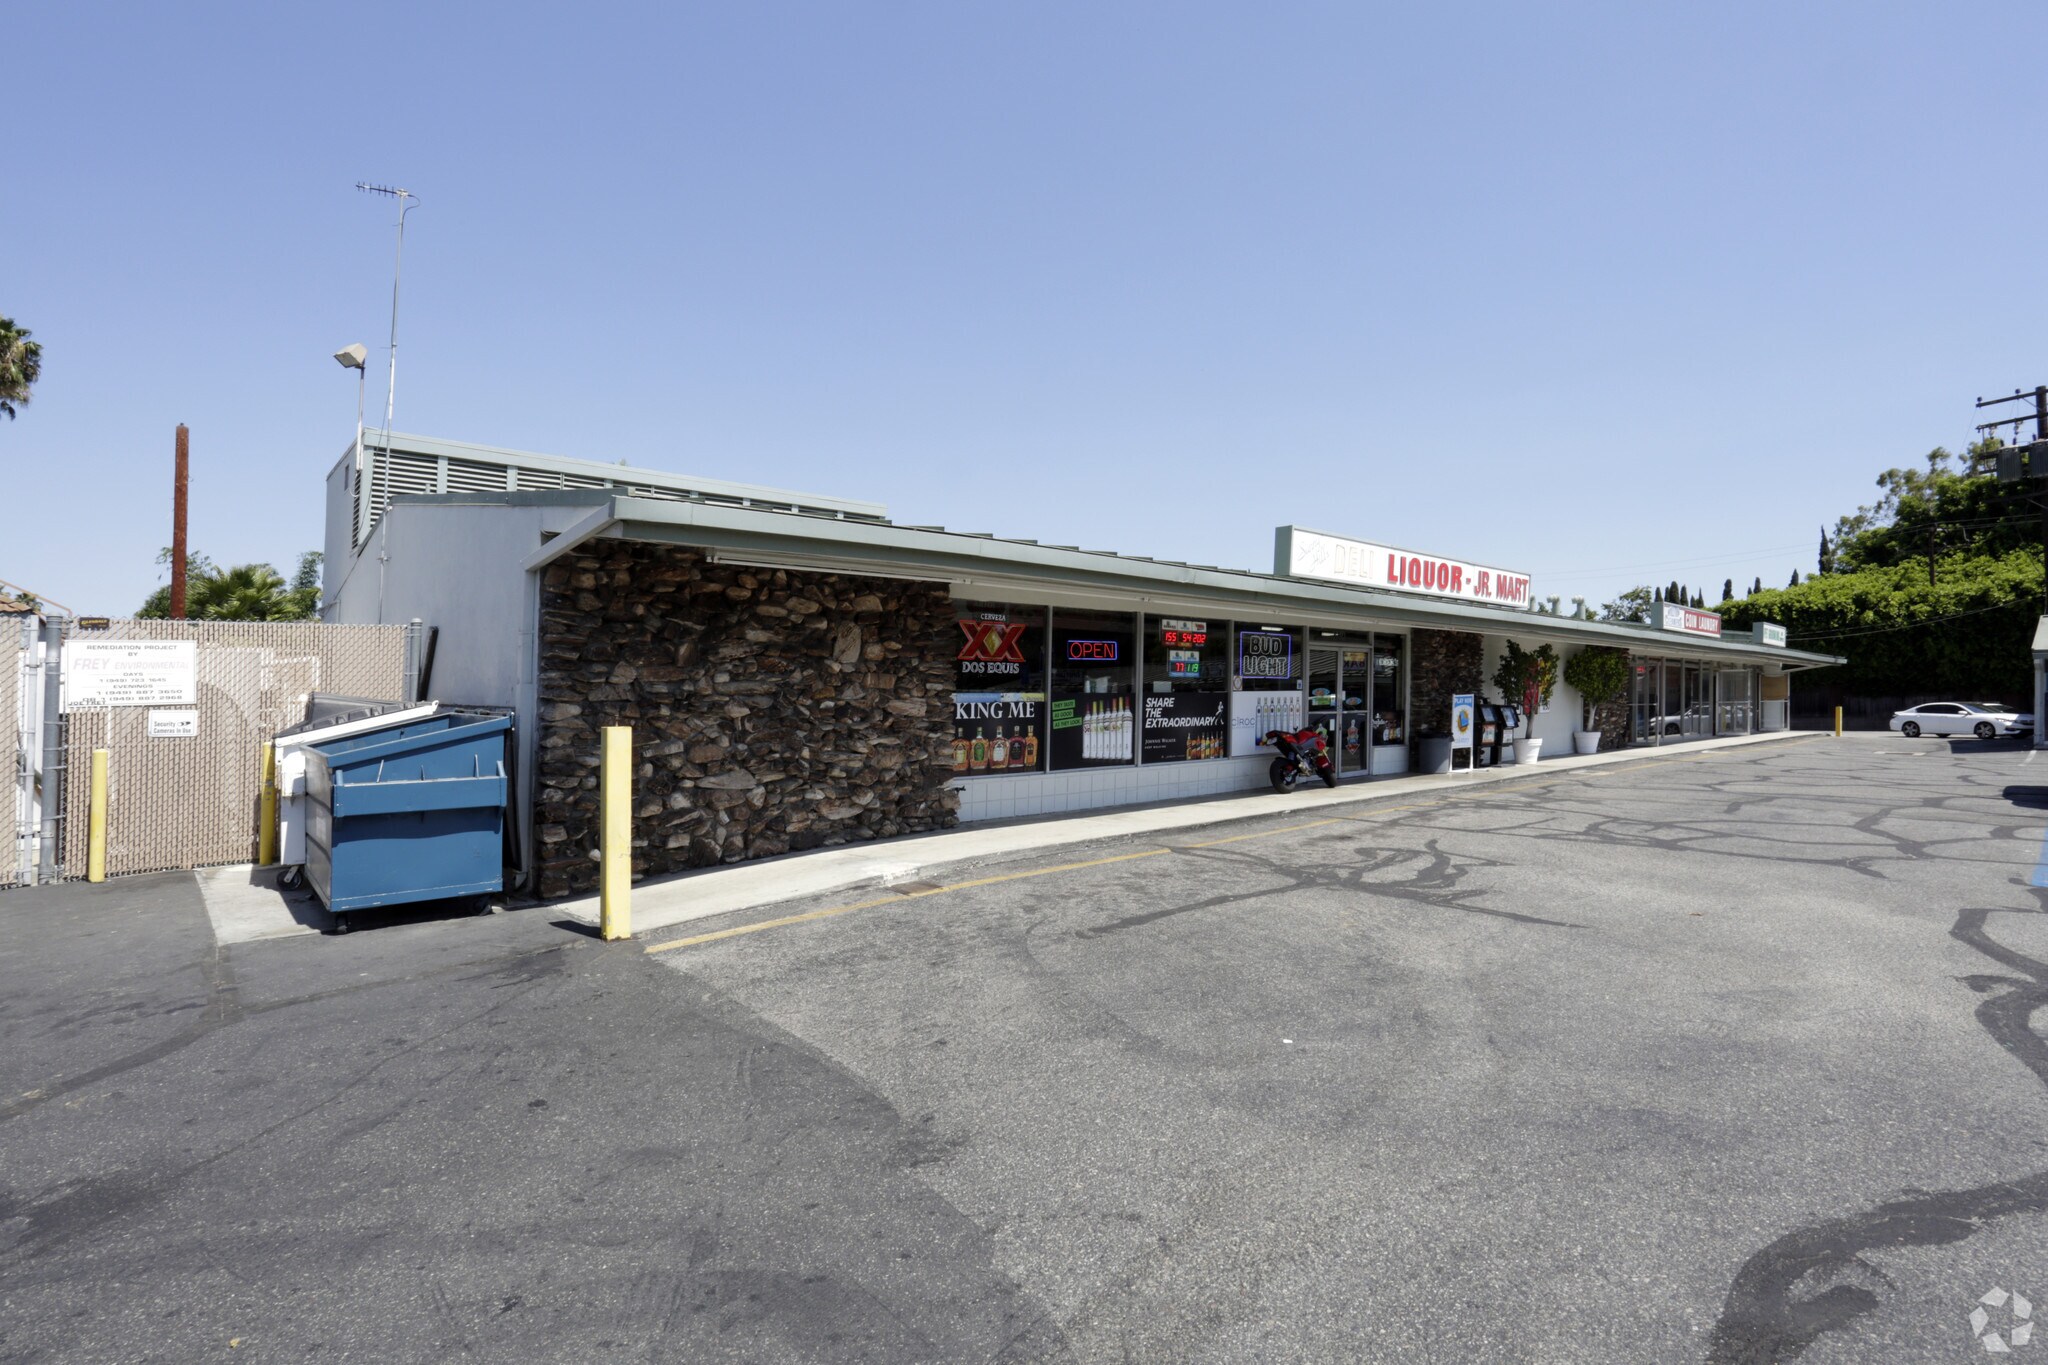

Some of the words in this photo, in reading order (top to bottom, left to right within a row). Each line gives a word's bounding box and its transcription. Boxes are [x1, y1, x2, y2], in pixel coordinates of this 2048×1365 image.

[1387, 553, 1463, 593] LIQUOR
[1496, 574, 1529, 603] MART
[980, 613, 1006, 621] CERVEZA
[1686, 613, 1697, 628] COIN
[1699, 616, 1718, 632] LAUNDRY
[1165, 632, 1177, 642] 155
[1182, 633, 1192, 642] 54
[1193, 634, 1206, 643] 202
[1070, 642, 1114, 658] OPEN
[1250, 635, 1282, 655] BUD
[73, 658, 110, 670] FREY
[962, 662, 985, 673] DOS
[987, 662, 1020, 674] EQUIS
[1243, 655, 1286, 676] LIGHT
[1146, 697, 1175, 707] SHARE
[955, 702, 1003, 719] KING
[1008, 702, 1035, 718] ME
[1145, 708, 1162, 717] THE
[1145, 716, 1216, 728] EXTRAORDINARY
